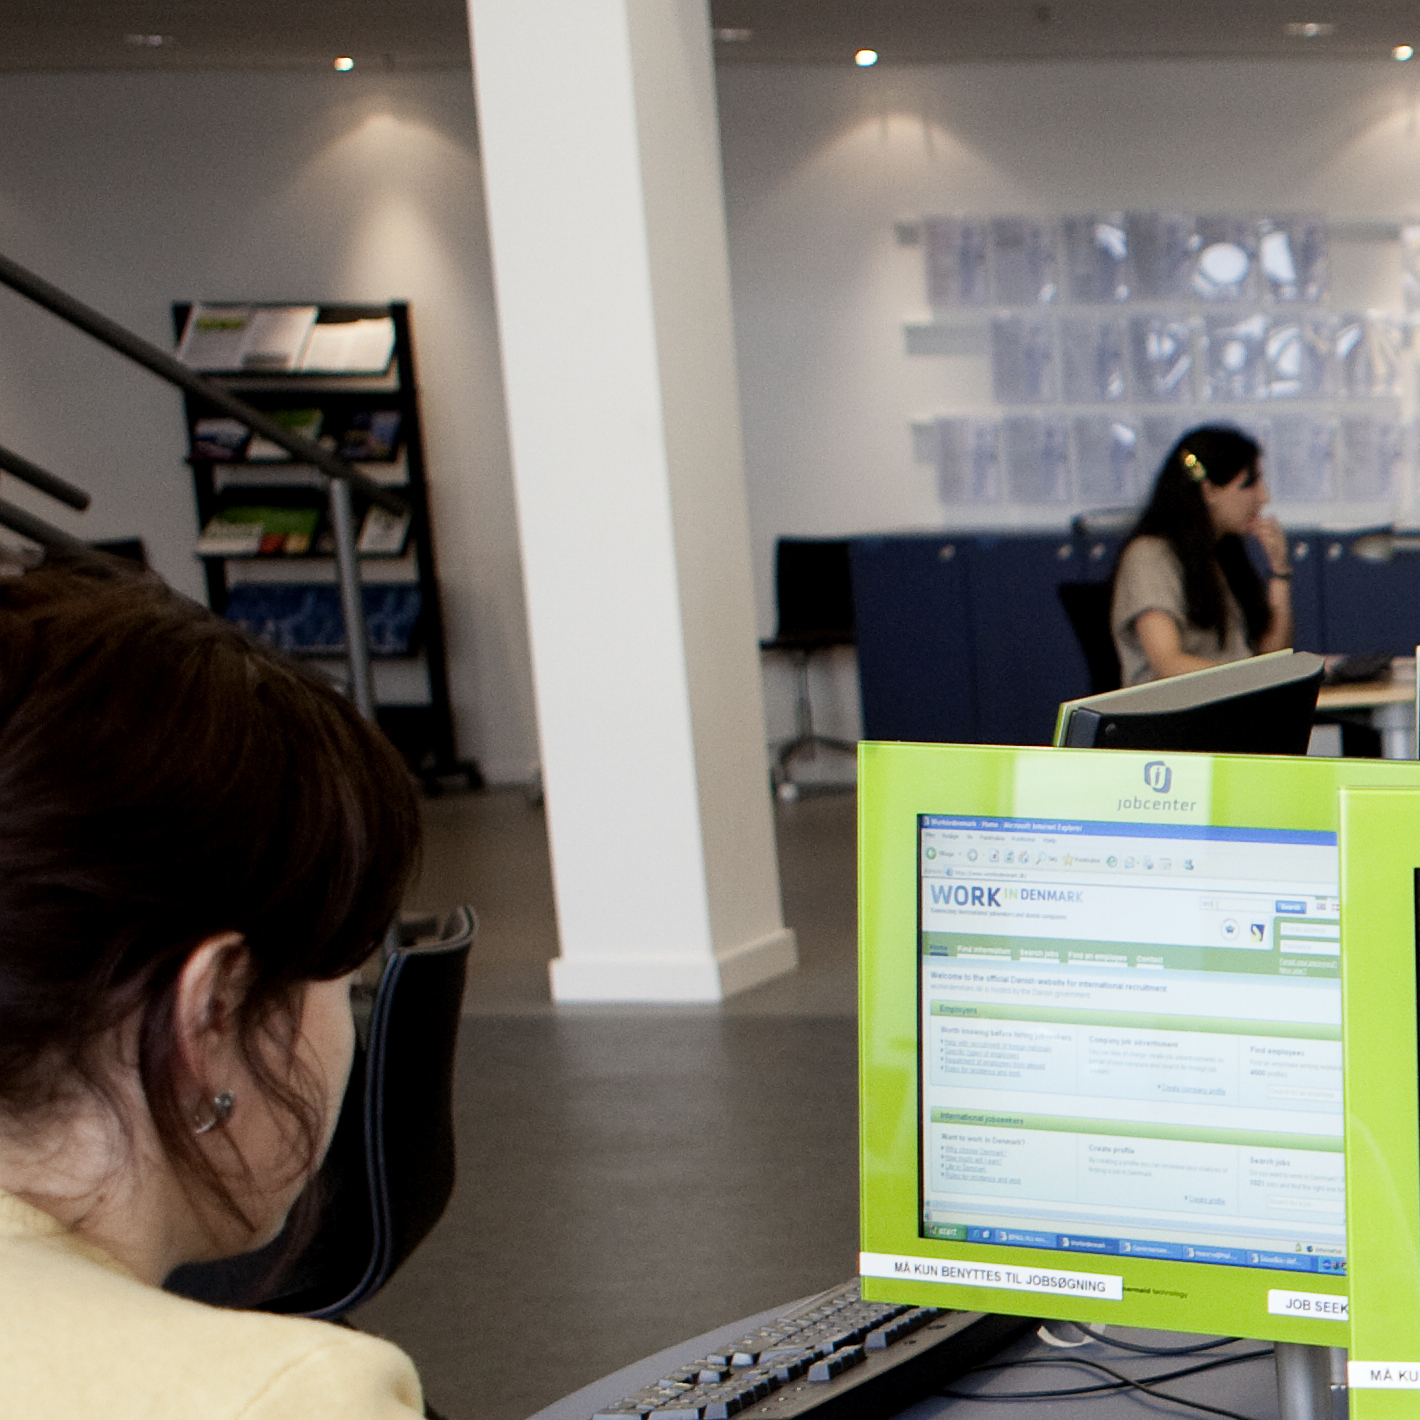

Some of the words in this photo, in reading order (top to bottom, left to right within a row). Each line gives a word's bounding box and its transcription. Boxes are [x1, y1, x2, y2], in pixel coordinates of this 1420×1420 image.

[1117, 796, 1196, 813] jobcenter
[931, 884, 1001, 907] WORK
[1005, 888, 1018, 899] IN
[1021, 888, 1083, 903] DENMARK
[931, 971, 963, 981] Welcome
[973, 974, 984, 982] the
[894, 1261, 911, 1273] MÅ
[914, 1263, 938, 1276] KUN
[941, 1266, 1002, 1282] BENYTTES
[1005, 1272, 1022, 1284] TIL
[1026, 1273, 1106, 1292] JOBSØGNING
[1286, 1298, 1311, 1311] JOB
[1316, 1300, 1348, 1314] SEEK
[1371, 1368, 1392, 1382] MÅ
